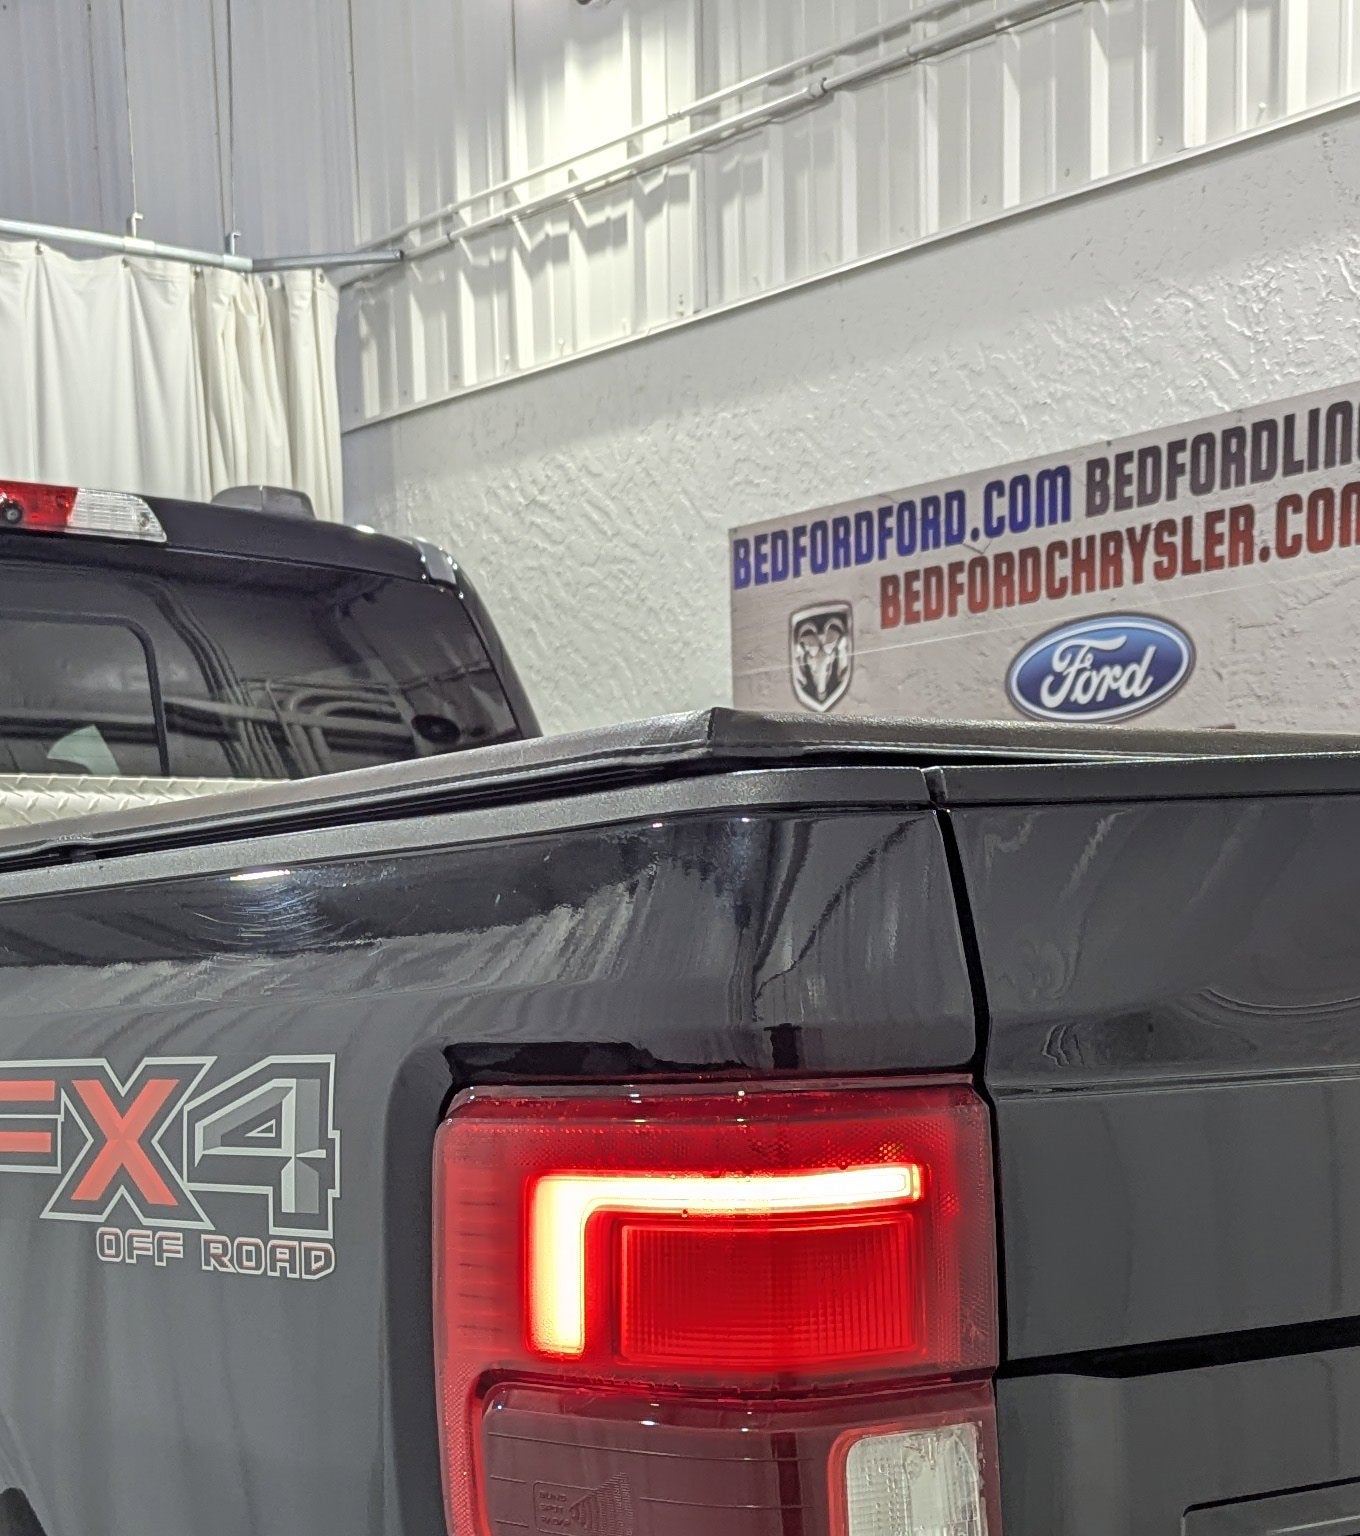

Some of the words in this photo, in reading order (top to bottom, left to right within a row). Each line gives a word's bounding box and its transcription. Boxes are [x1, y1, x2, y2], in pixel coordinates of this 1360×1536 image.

[733, 465, 1072, 590] BEDFORDFORD.COM
[1040, 634, 1158, 709] Ford
[96, 1226, 184, 1267] OFF
[200, 1233, 336, 1280] ROAD
